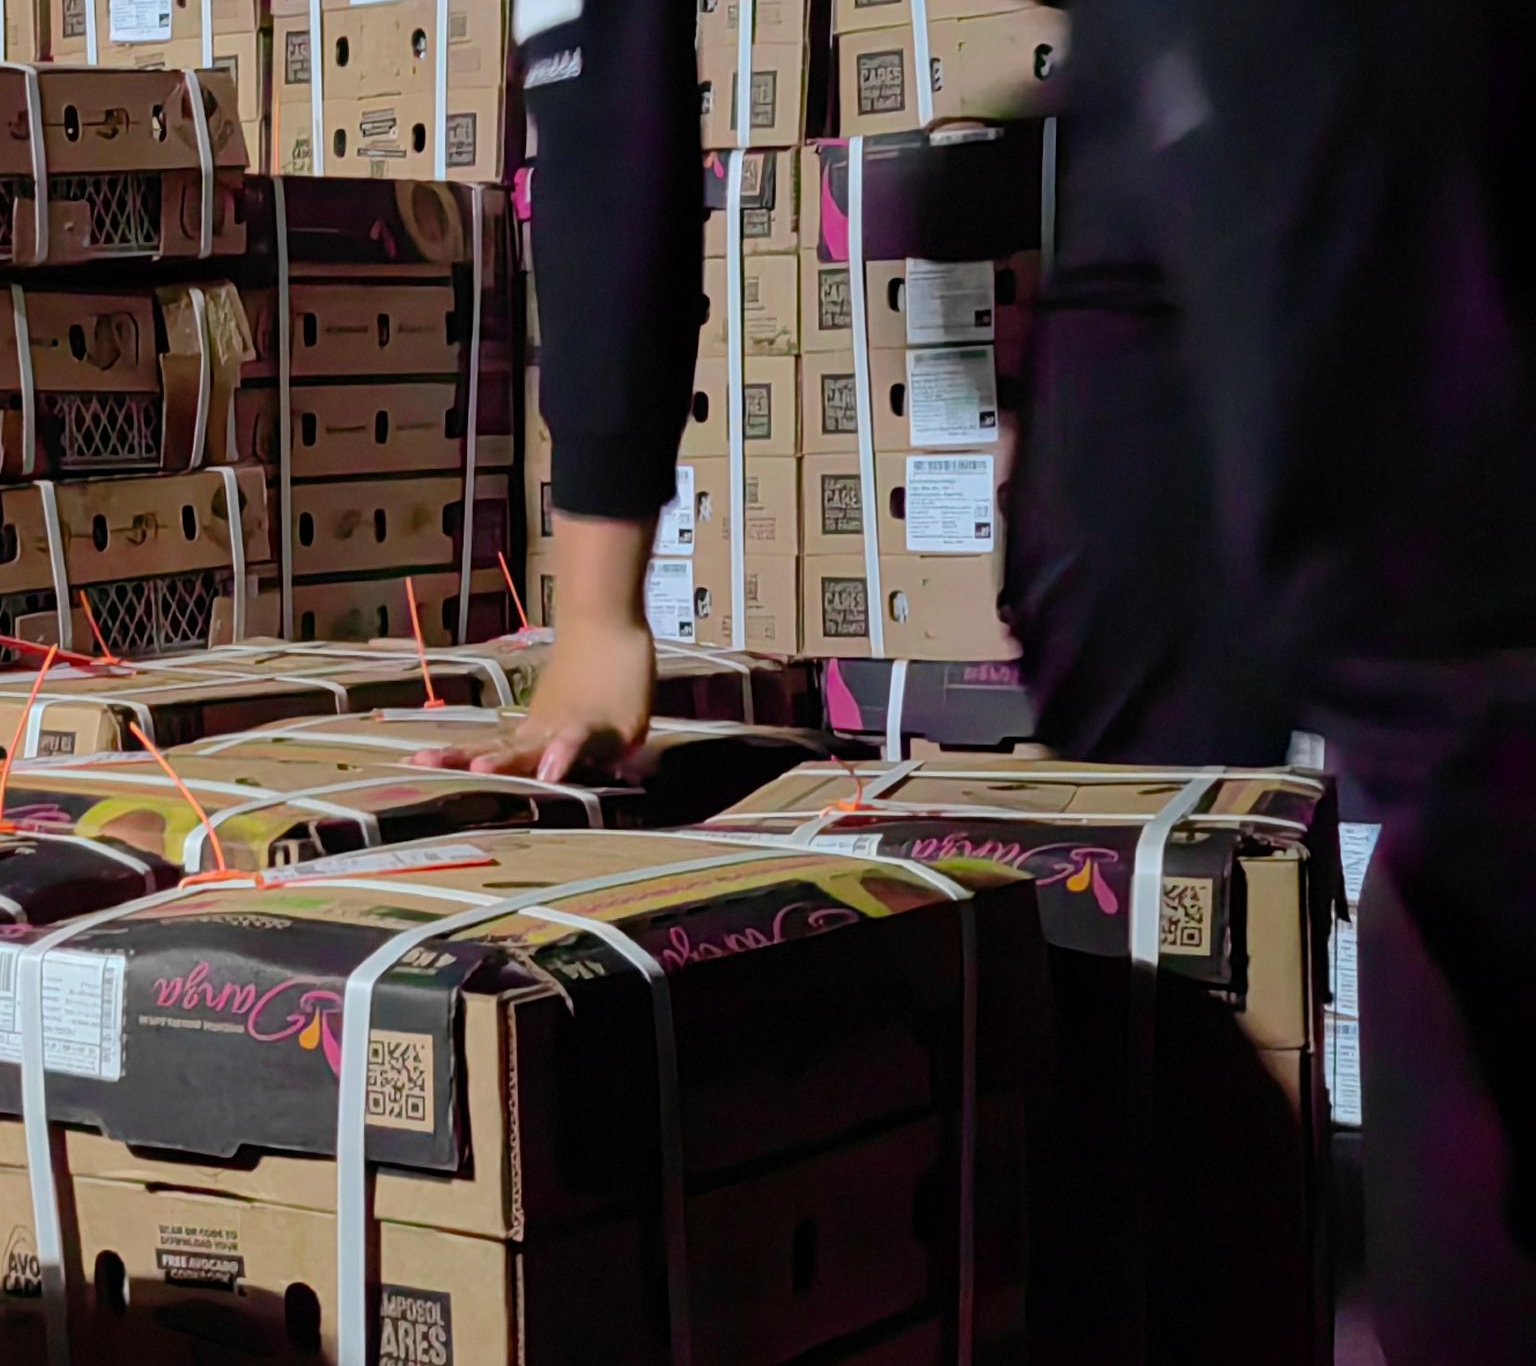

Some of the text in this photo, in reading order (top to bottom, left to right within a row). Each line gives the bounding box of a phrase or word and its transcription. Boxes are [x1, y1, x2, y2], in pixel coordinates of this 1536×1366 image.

[154, 961, 309, 1041] Danza
[380, 1291, 445, 1326] MPOSOL
[380, 1318, 447, 1366] ARES
